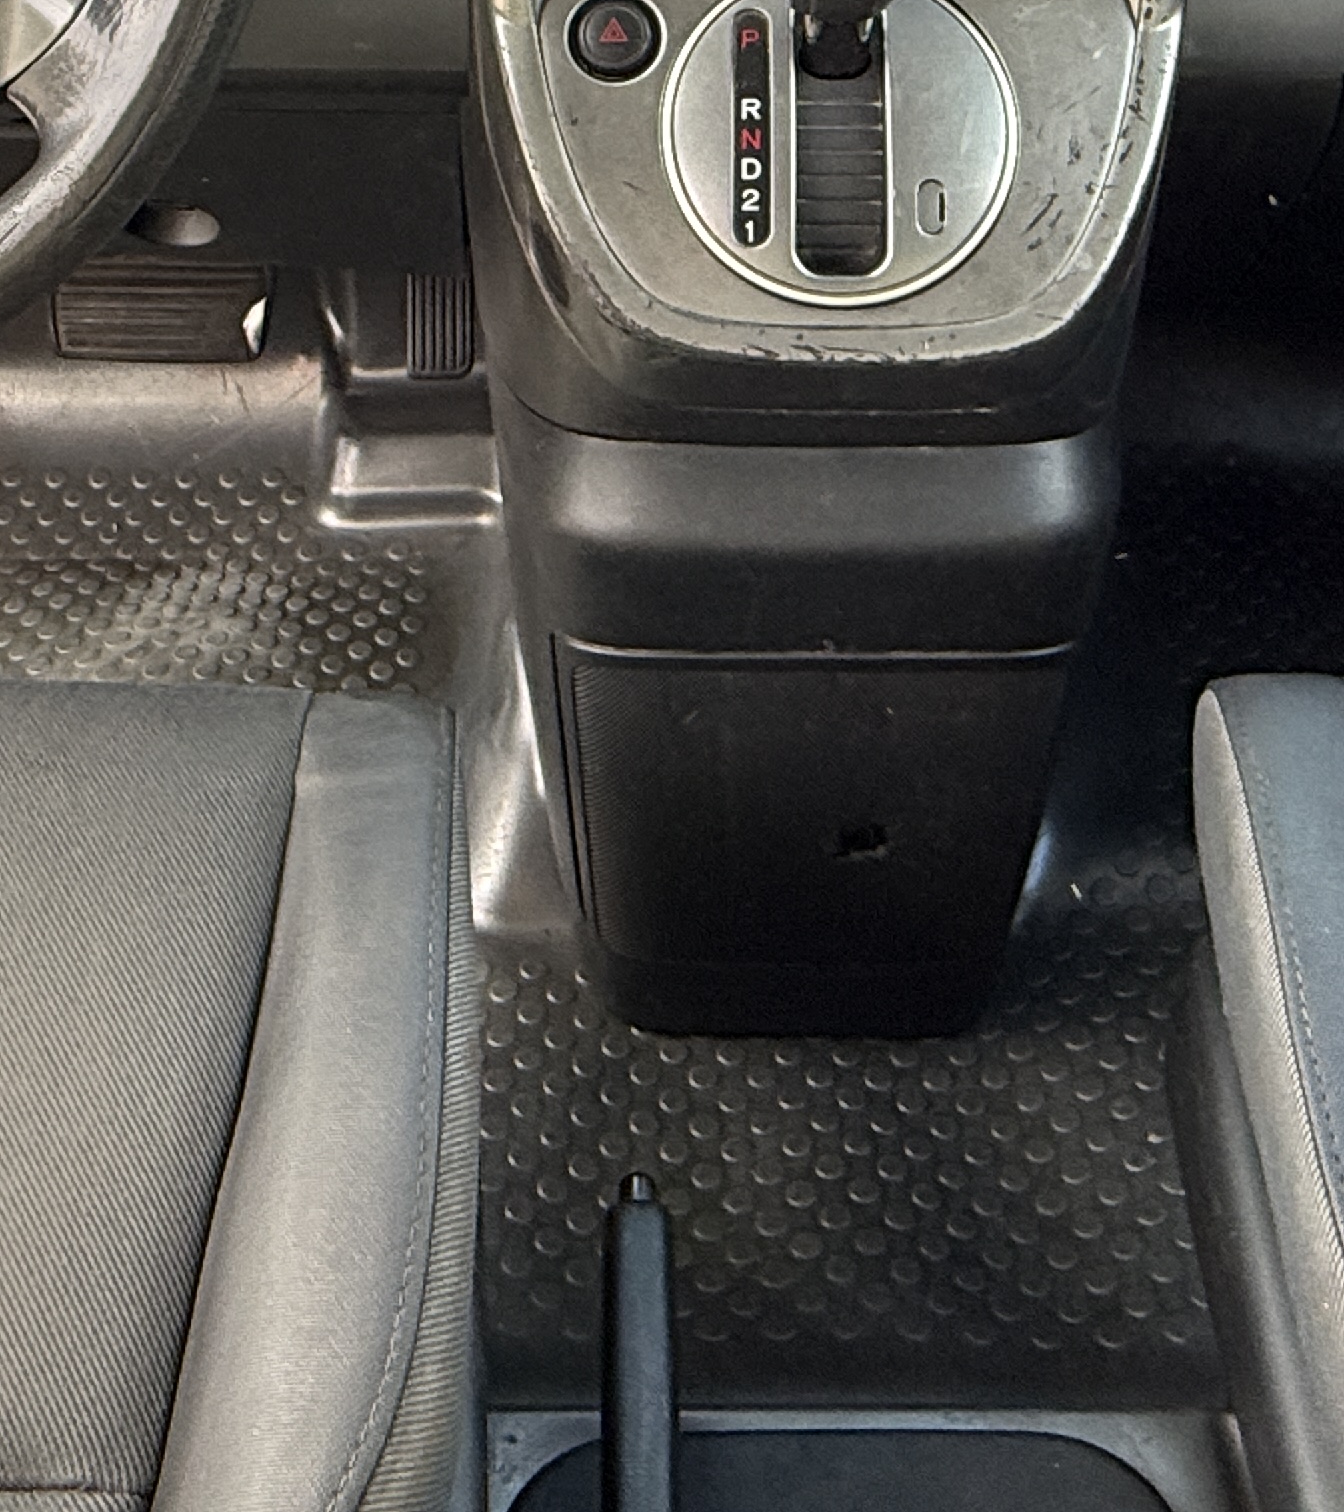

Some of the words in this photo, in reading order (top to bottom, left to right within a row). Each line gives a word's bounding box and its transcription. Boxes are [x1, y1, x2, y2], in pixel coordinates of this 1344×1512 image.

[740, 28, 760, 50] P
[740, 98, 761, 120] R
[740, 128, 761, 150] N
[740, 157, 762, 180] D
[740, 190, 760, 212] 2
[744, 220, 755, 243] 1
